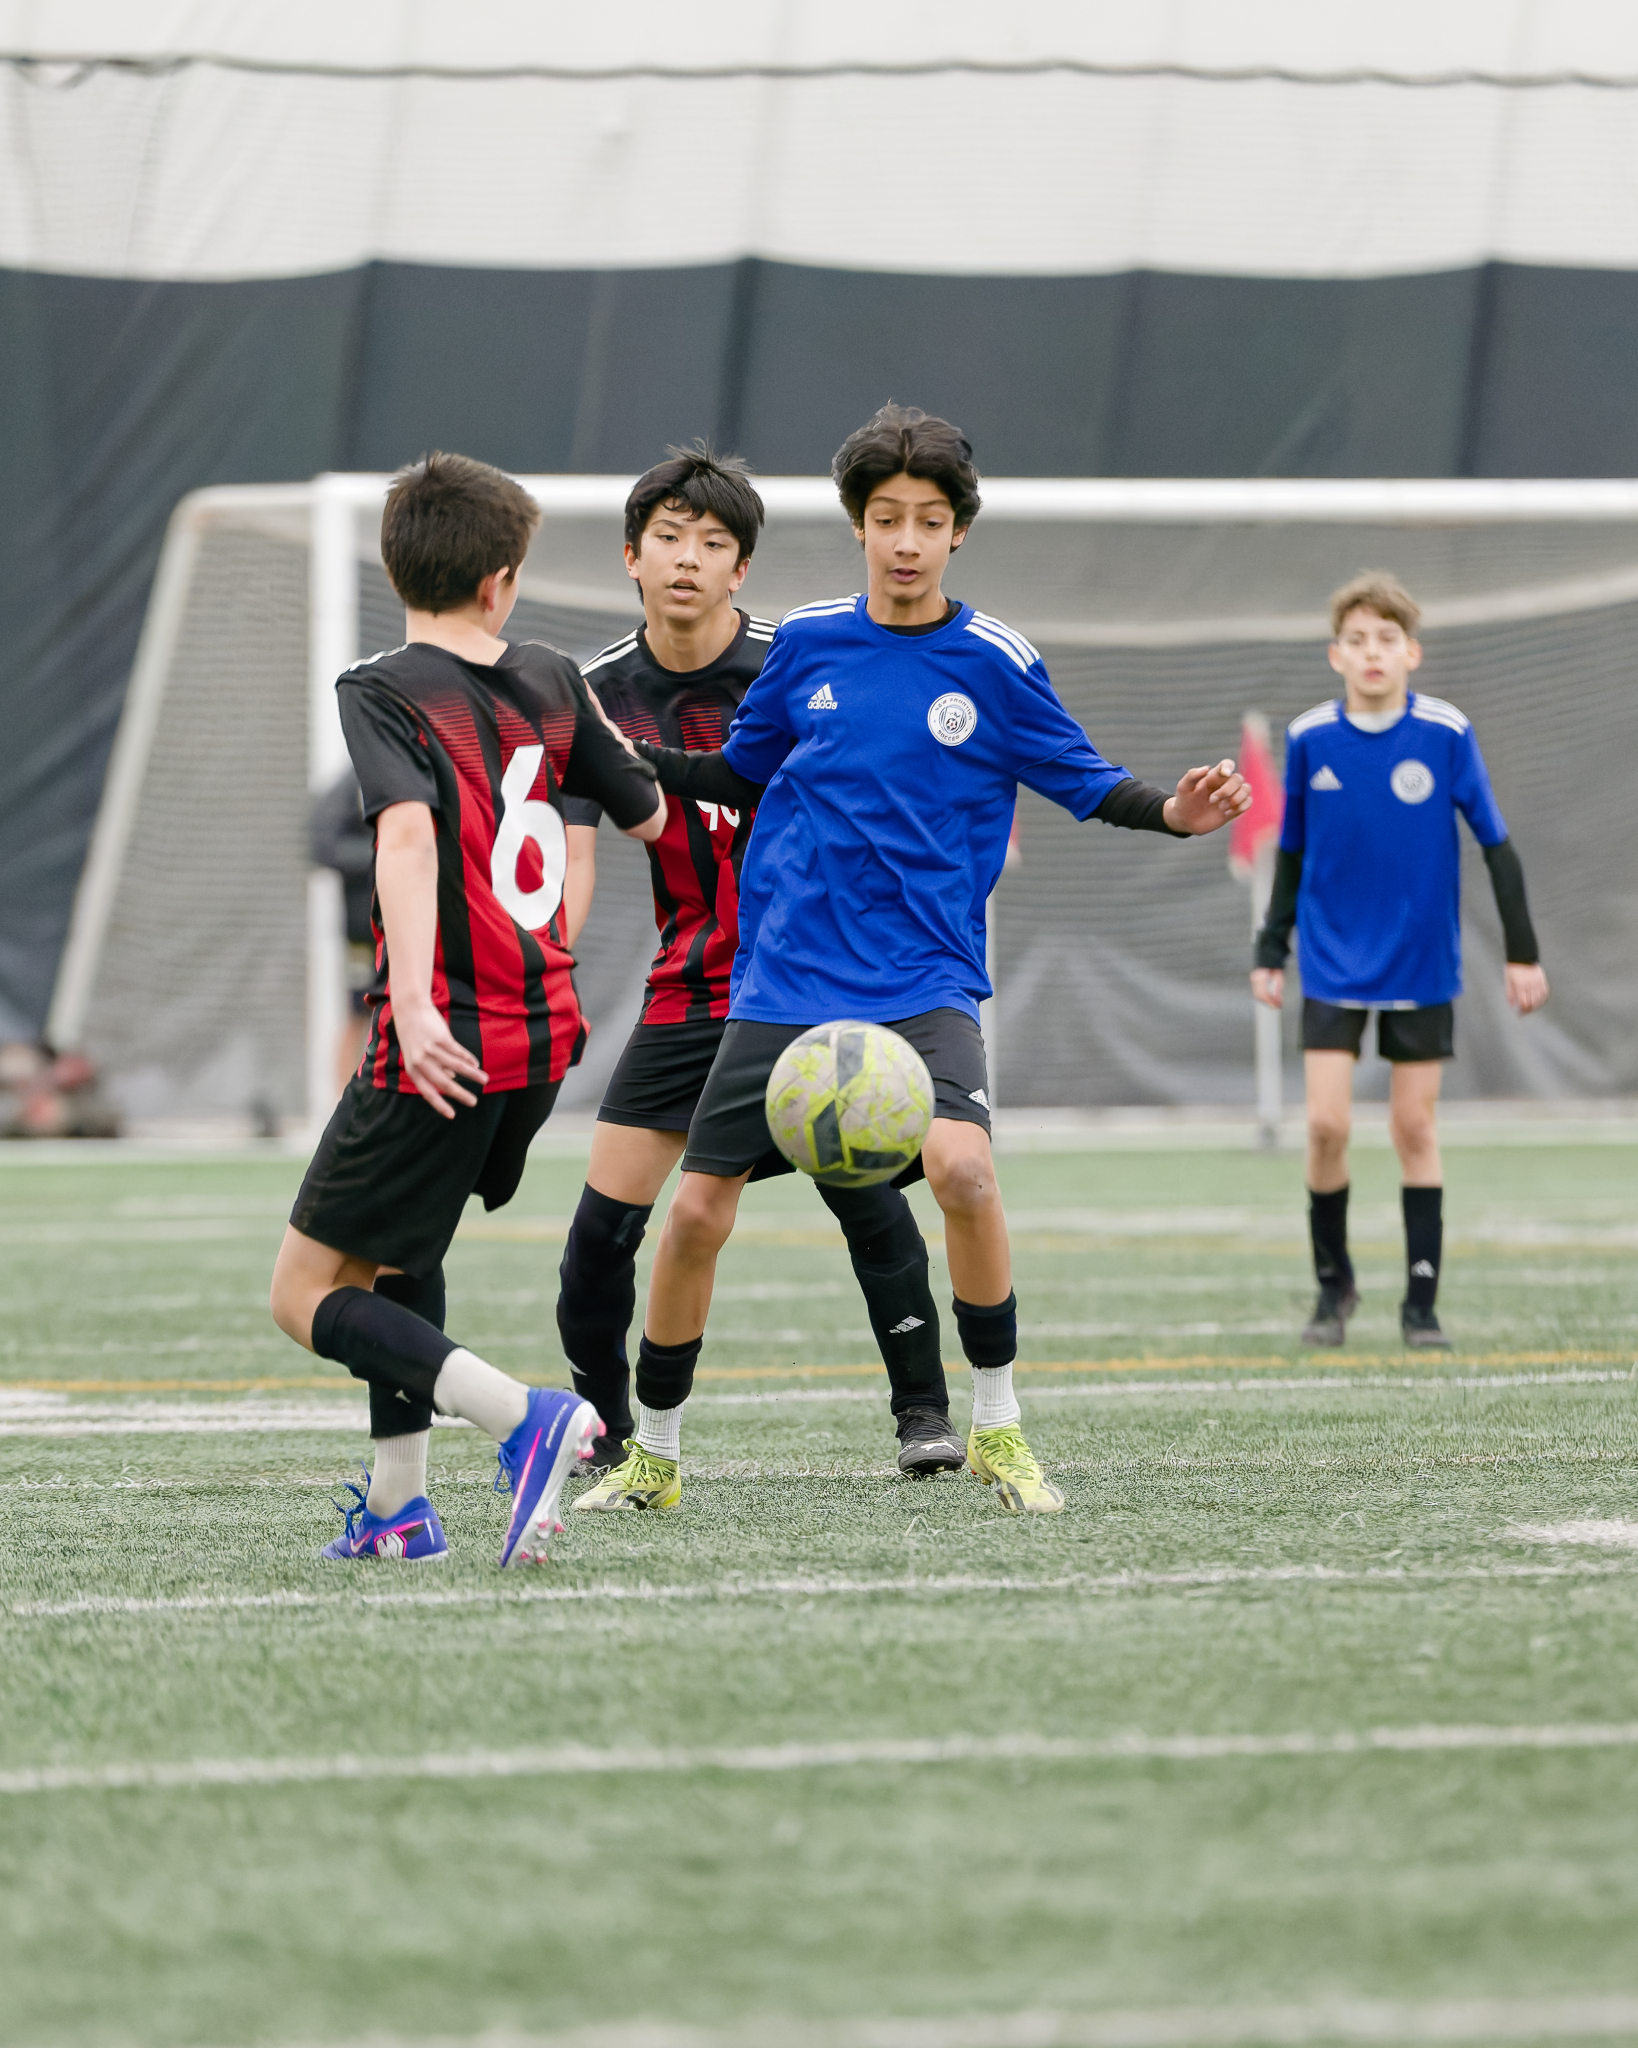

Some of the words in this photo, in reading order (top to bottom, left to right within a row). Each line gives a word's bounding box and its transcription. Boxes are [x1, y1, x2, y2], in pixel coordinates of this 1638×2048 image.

[807, 700, 838, 710] adidas
[936, 729, 960, 742] SOCCER
[490, 743, 568, 931] 6
